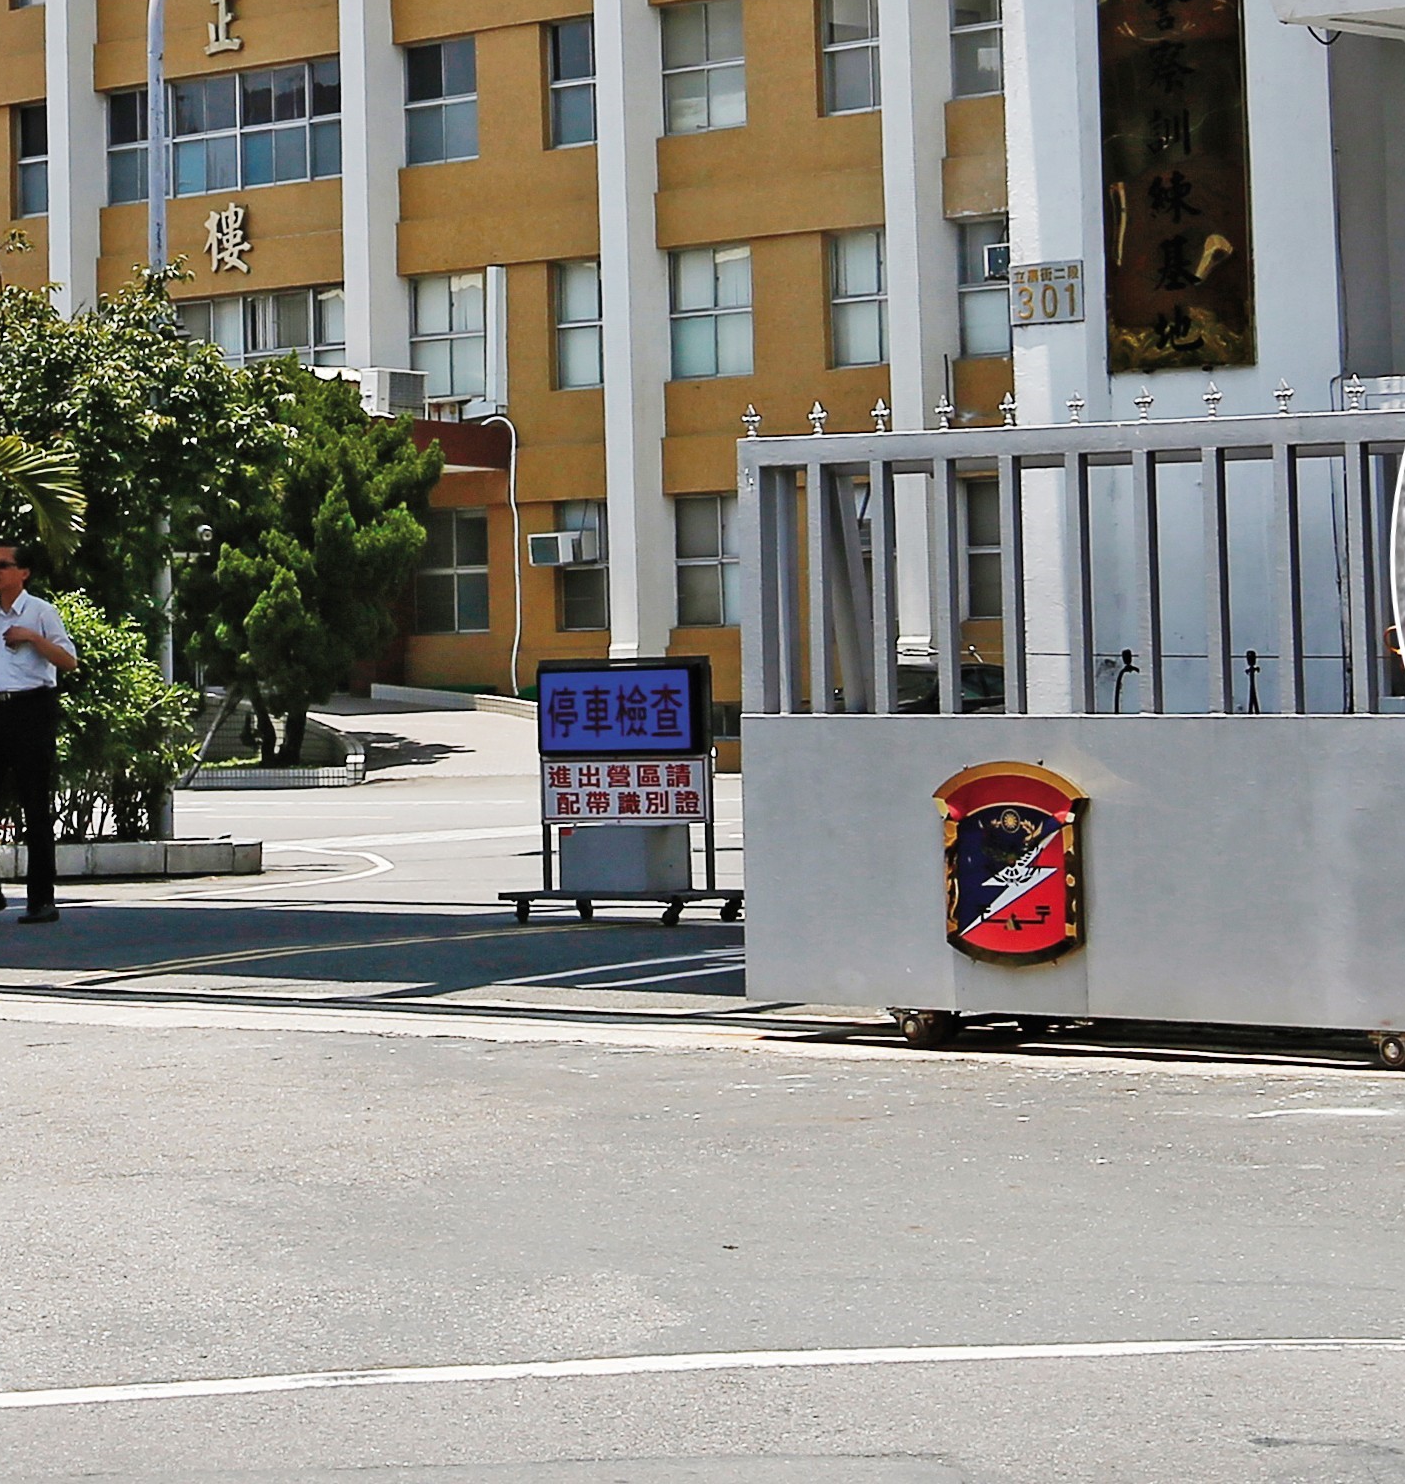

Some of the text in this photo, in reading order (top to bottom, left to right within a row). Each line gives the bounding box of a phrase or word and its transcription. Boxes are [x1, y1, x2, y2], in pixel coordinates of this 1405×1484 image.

[1017, 283, 1076, 320] 301
[547, 684, 684, 738] 停車檢查
[548, 763, 691, 788] 進出營區請
[556, 790, 701, 815] 配帶識別證
